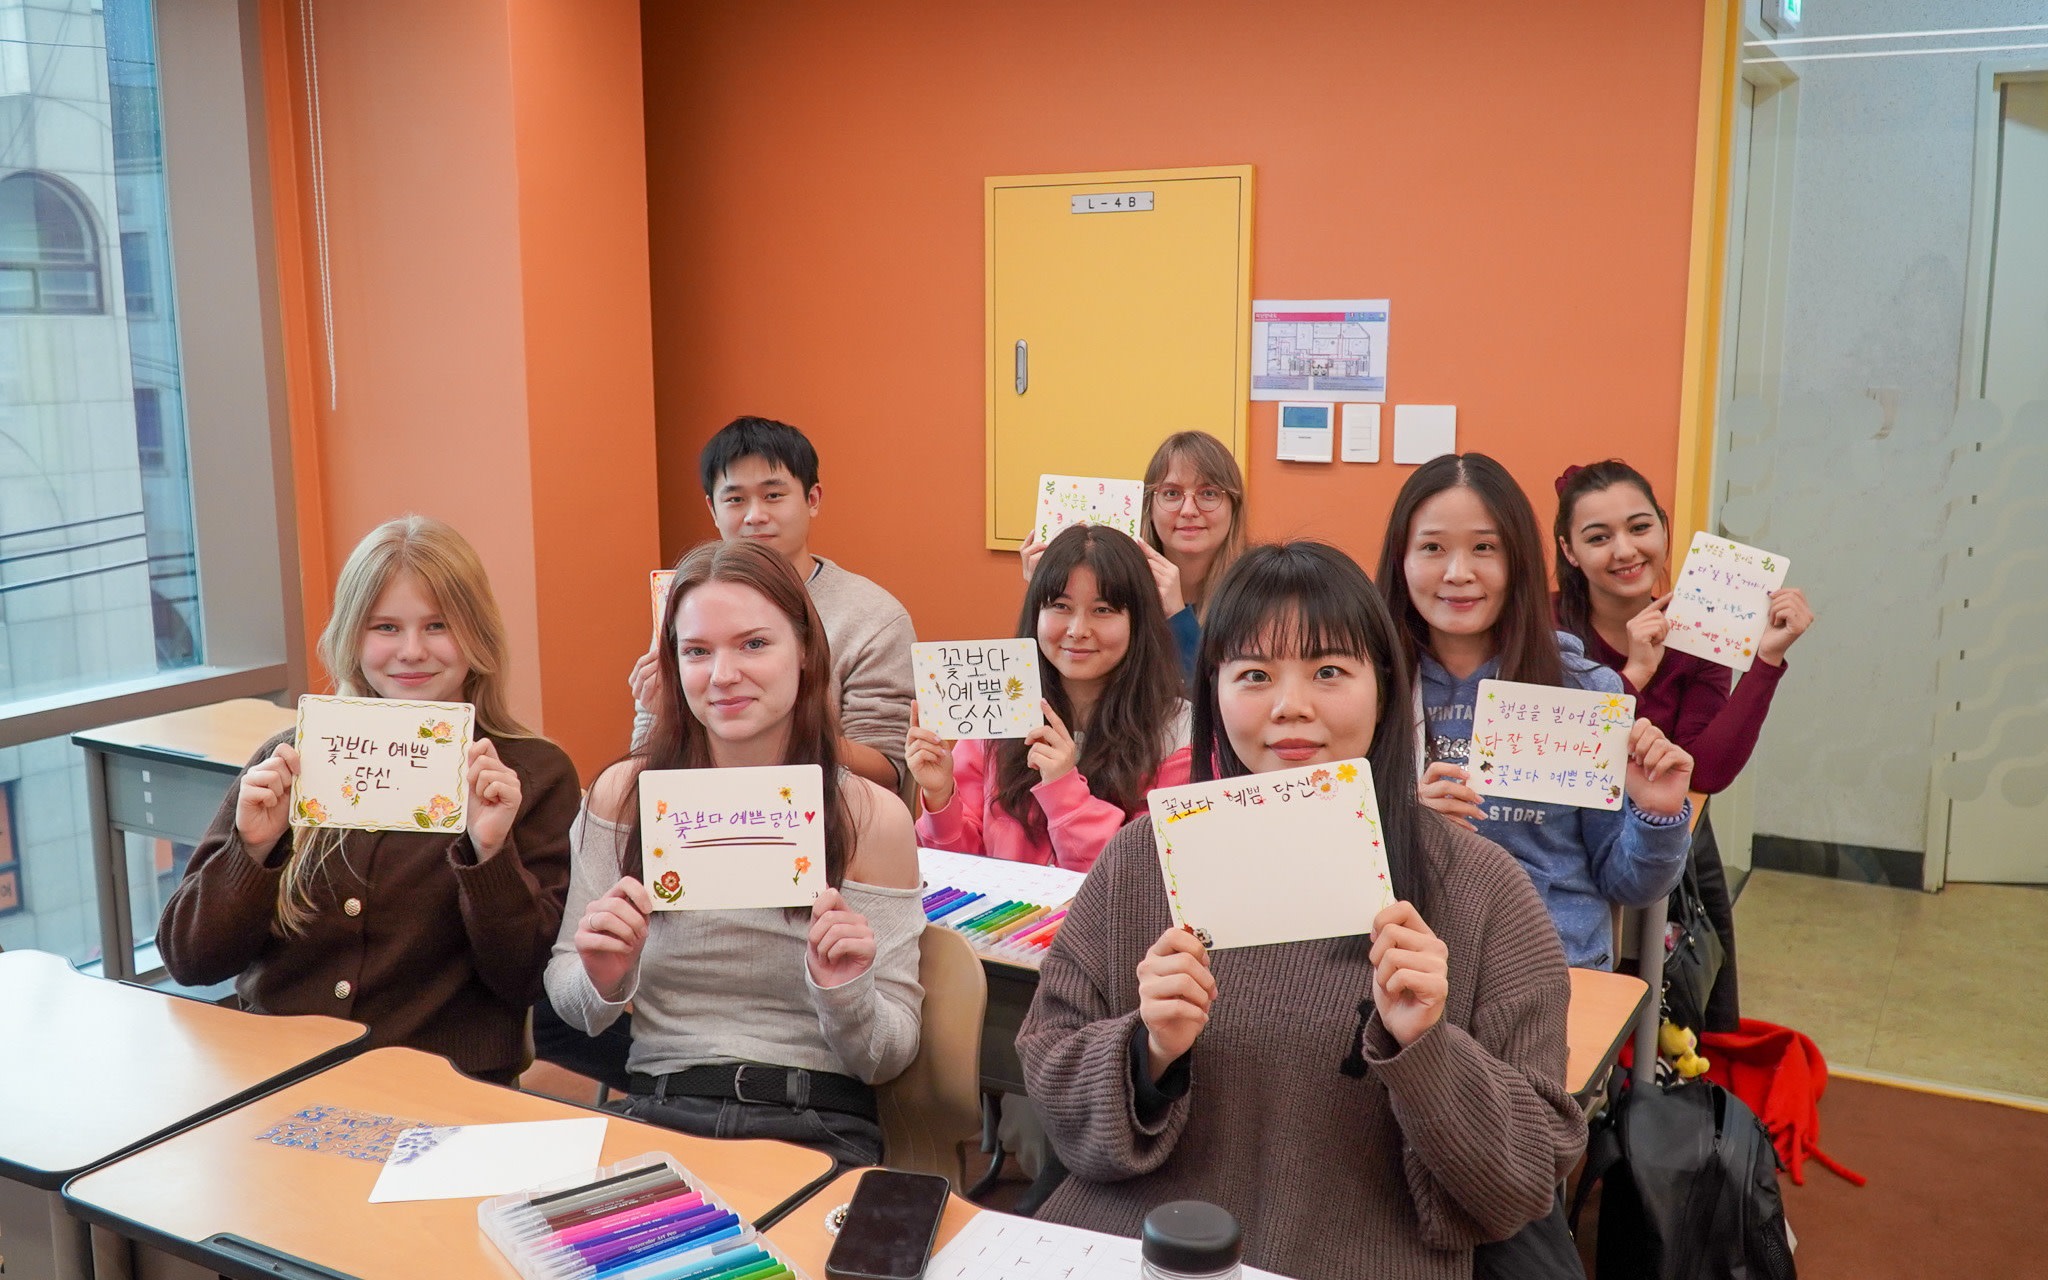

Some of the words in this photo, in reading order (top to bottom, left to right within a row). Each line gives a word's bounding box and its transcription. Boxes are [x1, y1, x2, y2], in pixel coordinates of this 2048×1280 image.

[938, 647, 1010, 680] 꽃보다
[948, 679, 1003, 701] 예쁜
[948, 704, 1003, 735] 당신
[1500, 701, 1540, 722] 행운을
[1552, 706, 1600, 726] 빌어요
[321, 735, 378, 765] 꽃보다
[388, 741, 429, 769] 예쁜
[1498, 765, 1539, 786] 꽃보다
[1550, 770, 1578, 788] 예쁜
[1585, 771, 1614, 791] 당신
[1161, 796, 1214, 820] 꽃보다
[1272, 777, 1316, 802] 당신
[668, 810, 723, 839] 꽃보다
[1489, 805, 1546, 825] STORE
